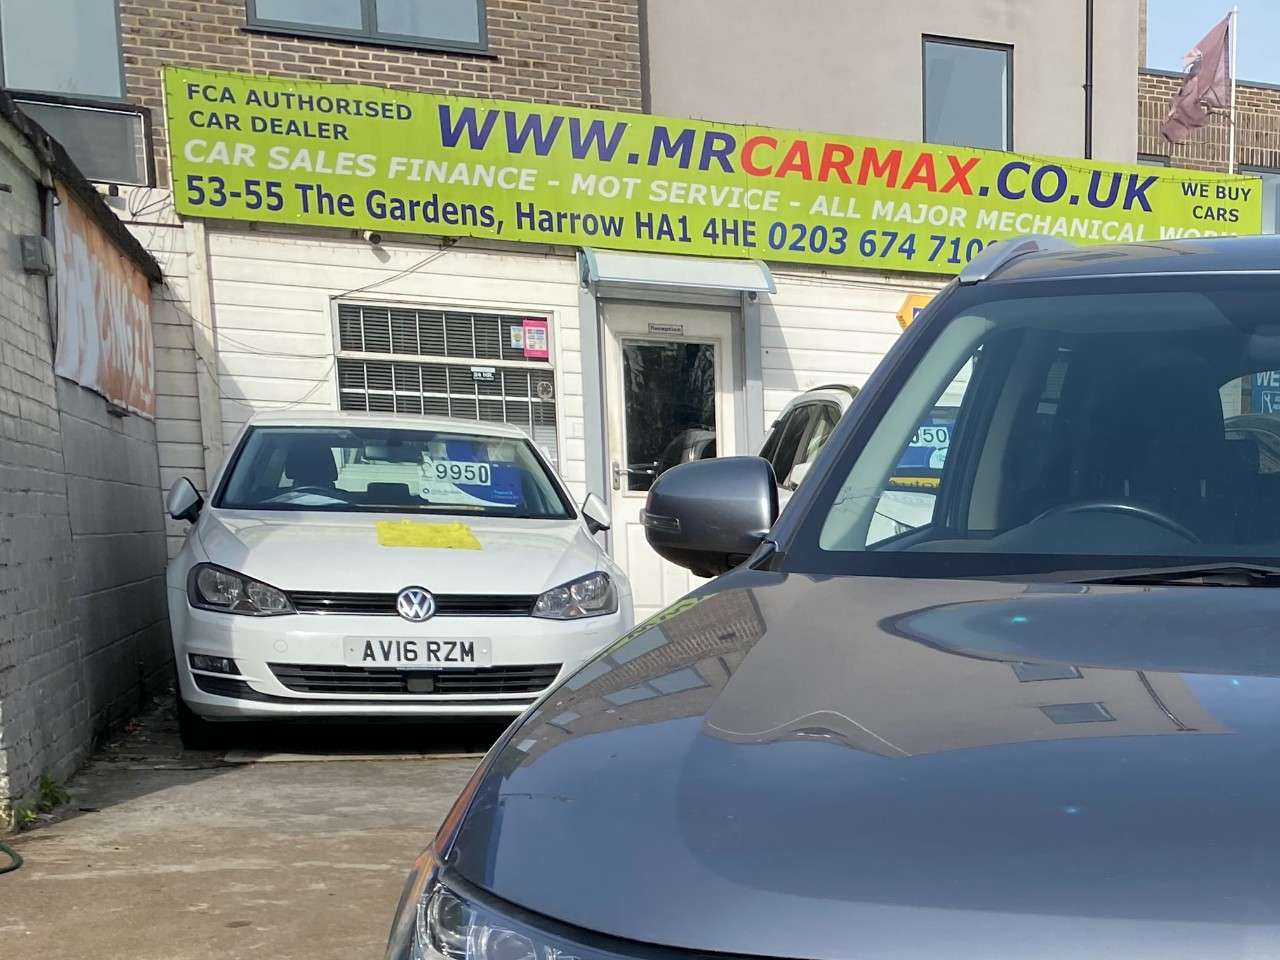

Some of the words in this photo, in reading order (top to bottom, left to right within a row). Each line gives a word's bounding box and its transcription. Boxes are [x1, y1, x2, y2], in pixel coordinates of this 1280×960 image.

[186, 83, 236, 105] FCA
[244, 89, 412, 121] AUTHORISED
[189, 110, 241, 132] CAR
[251, 115, 349, 141] DEALER
[437, 104, 1158, 214] WWW.MRCARMAX.CO.UK
[184, 139, 257, 167] CAR
[267, 148, 377, 178] SALES
[387, 156, 537, 191] FINANCE
[570, 174, 641, 201] MOT
[649, 180, 779, 212] SERVICE
[809, 196, 865, 220] ALL
[871, 201, 967, 230] MAJOR
[976, 210, 1145, 243] MECHANICAL
[1182, 181, 1208, 197] WE
[1215, 185, 1252, 202] BUY
[185, 174, 284, 212] 53-55
[294, 183, 356, 217] The
[365, 188, 505, 234] Gardens,
[515, 201, 625, 239] Harrow
[634, 210, 692, 244] HA1
[702, 217, 758, 248] 4HE
[767, 221, 848, 255] 0203
[858, 233, 917, 261] 674
[927, 235, 998, 266] 710
[1192, 205, 1240, 223] CARS
[1256, 370, 1280, 387] WE
[435, 463, 490, 484] 9950
[361, 640, 418, 662] AV16
[426, 641, 475, 662] RZM
